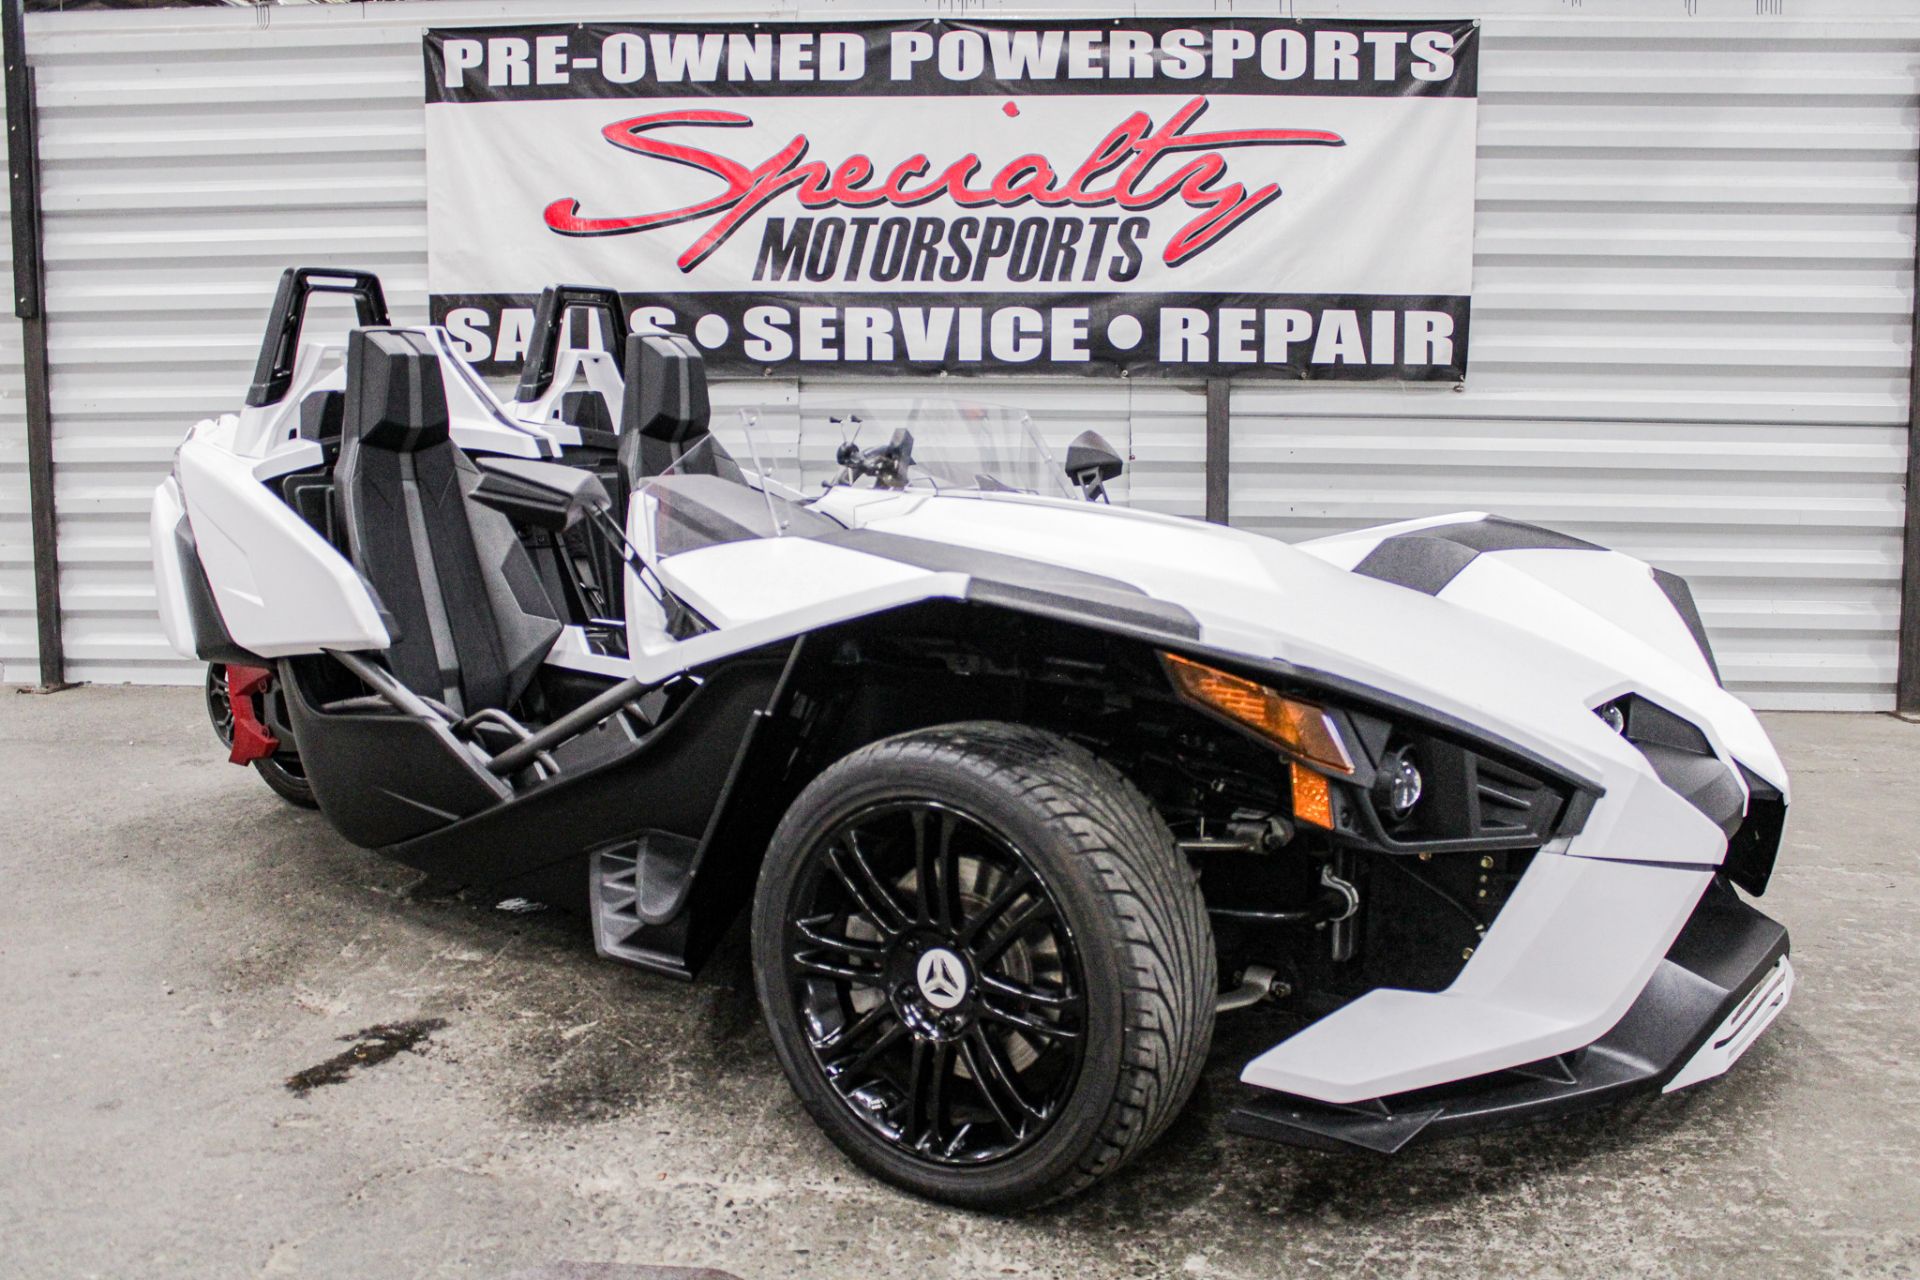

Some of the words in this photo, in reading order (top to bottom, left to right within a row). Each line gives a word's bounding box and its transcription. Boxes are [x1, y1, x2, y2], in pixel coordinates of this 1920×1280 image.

[443, 33, 866, 89] PRE-OWNED
[889, 29, 1456, 83] POWERSPORTS
[543, 96, 1346, 273] Specialty
[752, 216, 1149, 283] MOTORSPORTS
[743, 306, 1090, 362] SERVICE
[1159, 306, 1455, 366] REPAIR
